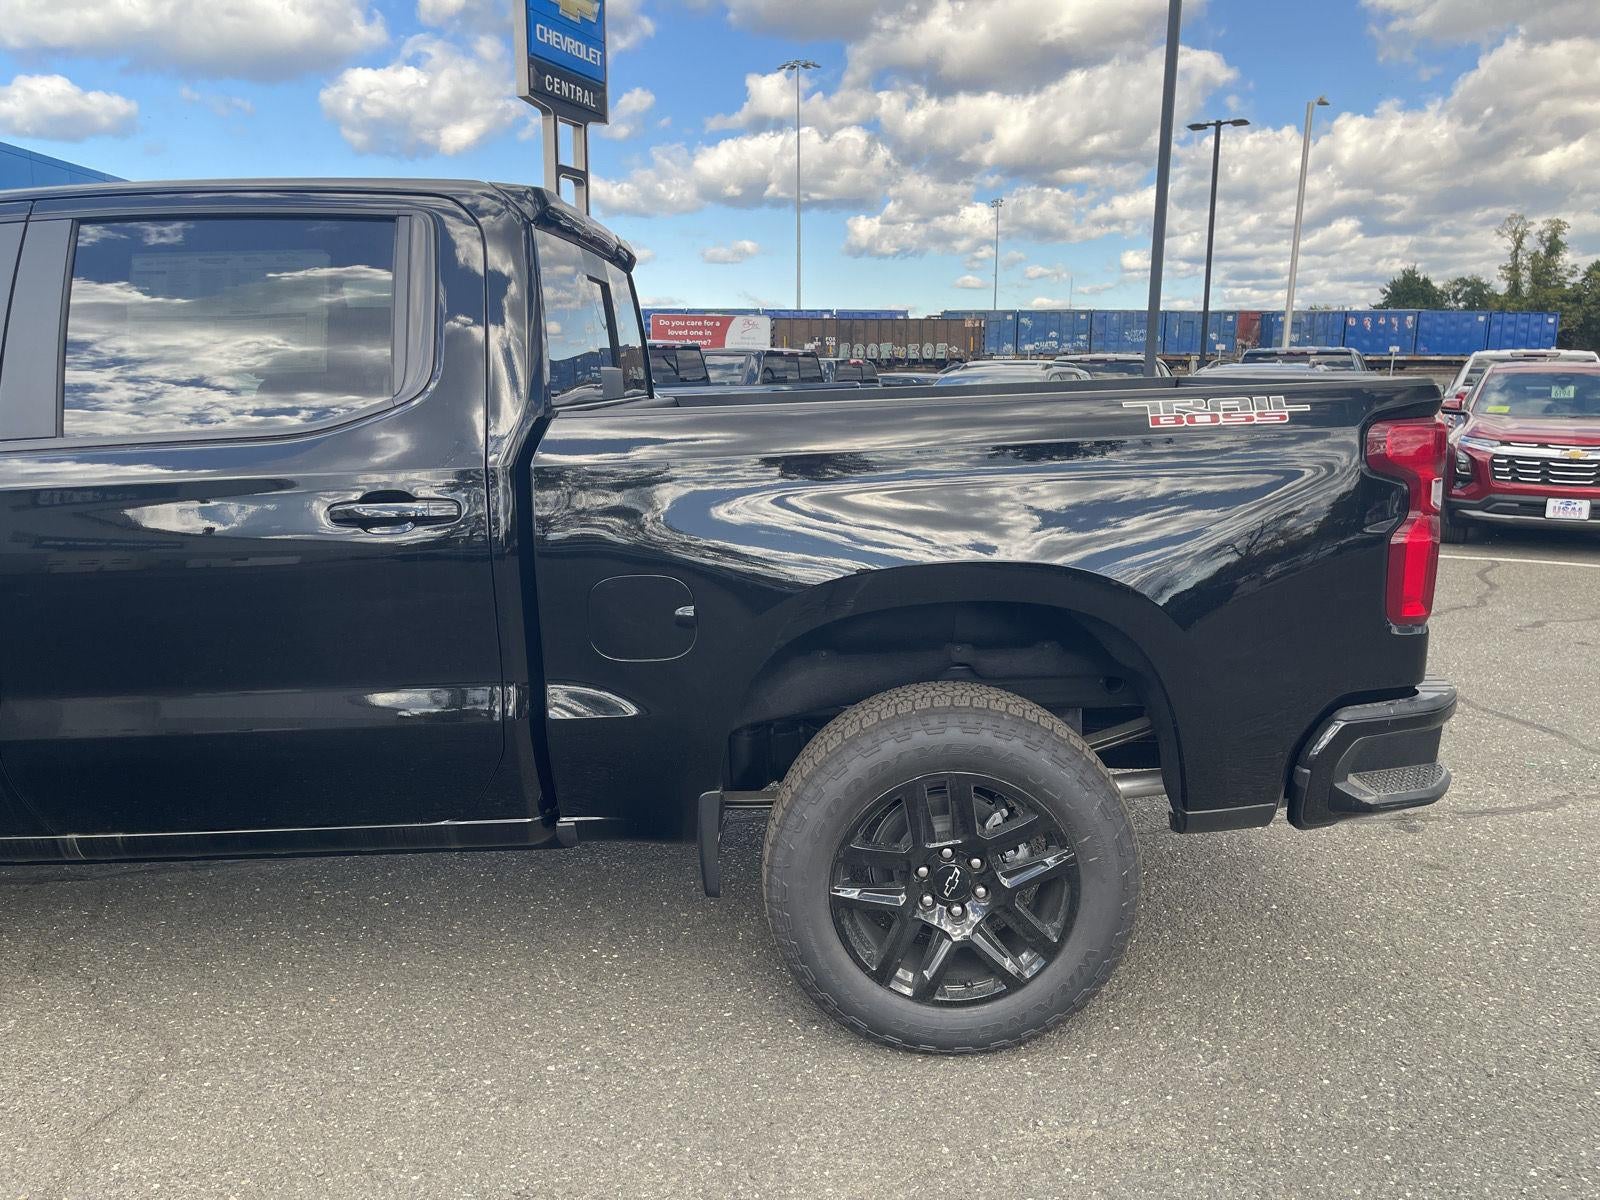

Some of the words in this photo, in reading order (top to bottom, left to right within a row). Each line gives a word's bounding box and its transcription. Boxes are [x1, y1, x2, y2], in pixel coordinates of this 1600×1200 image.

[536, 23, 602, 66] CHEVROLET
[545, 74, 596, 108] CENTRAL
[671, 320, 685, 328] you
[703, 319, 714, 327] for
[1122, 395, 1311, 415] TRAIL
[1149, 410, 1289, 428] BOSS
